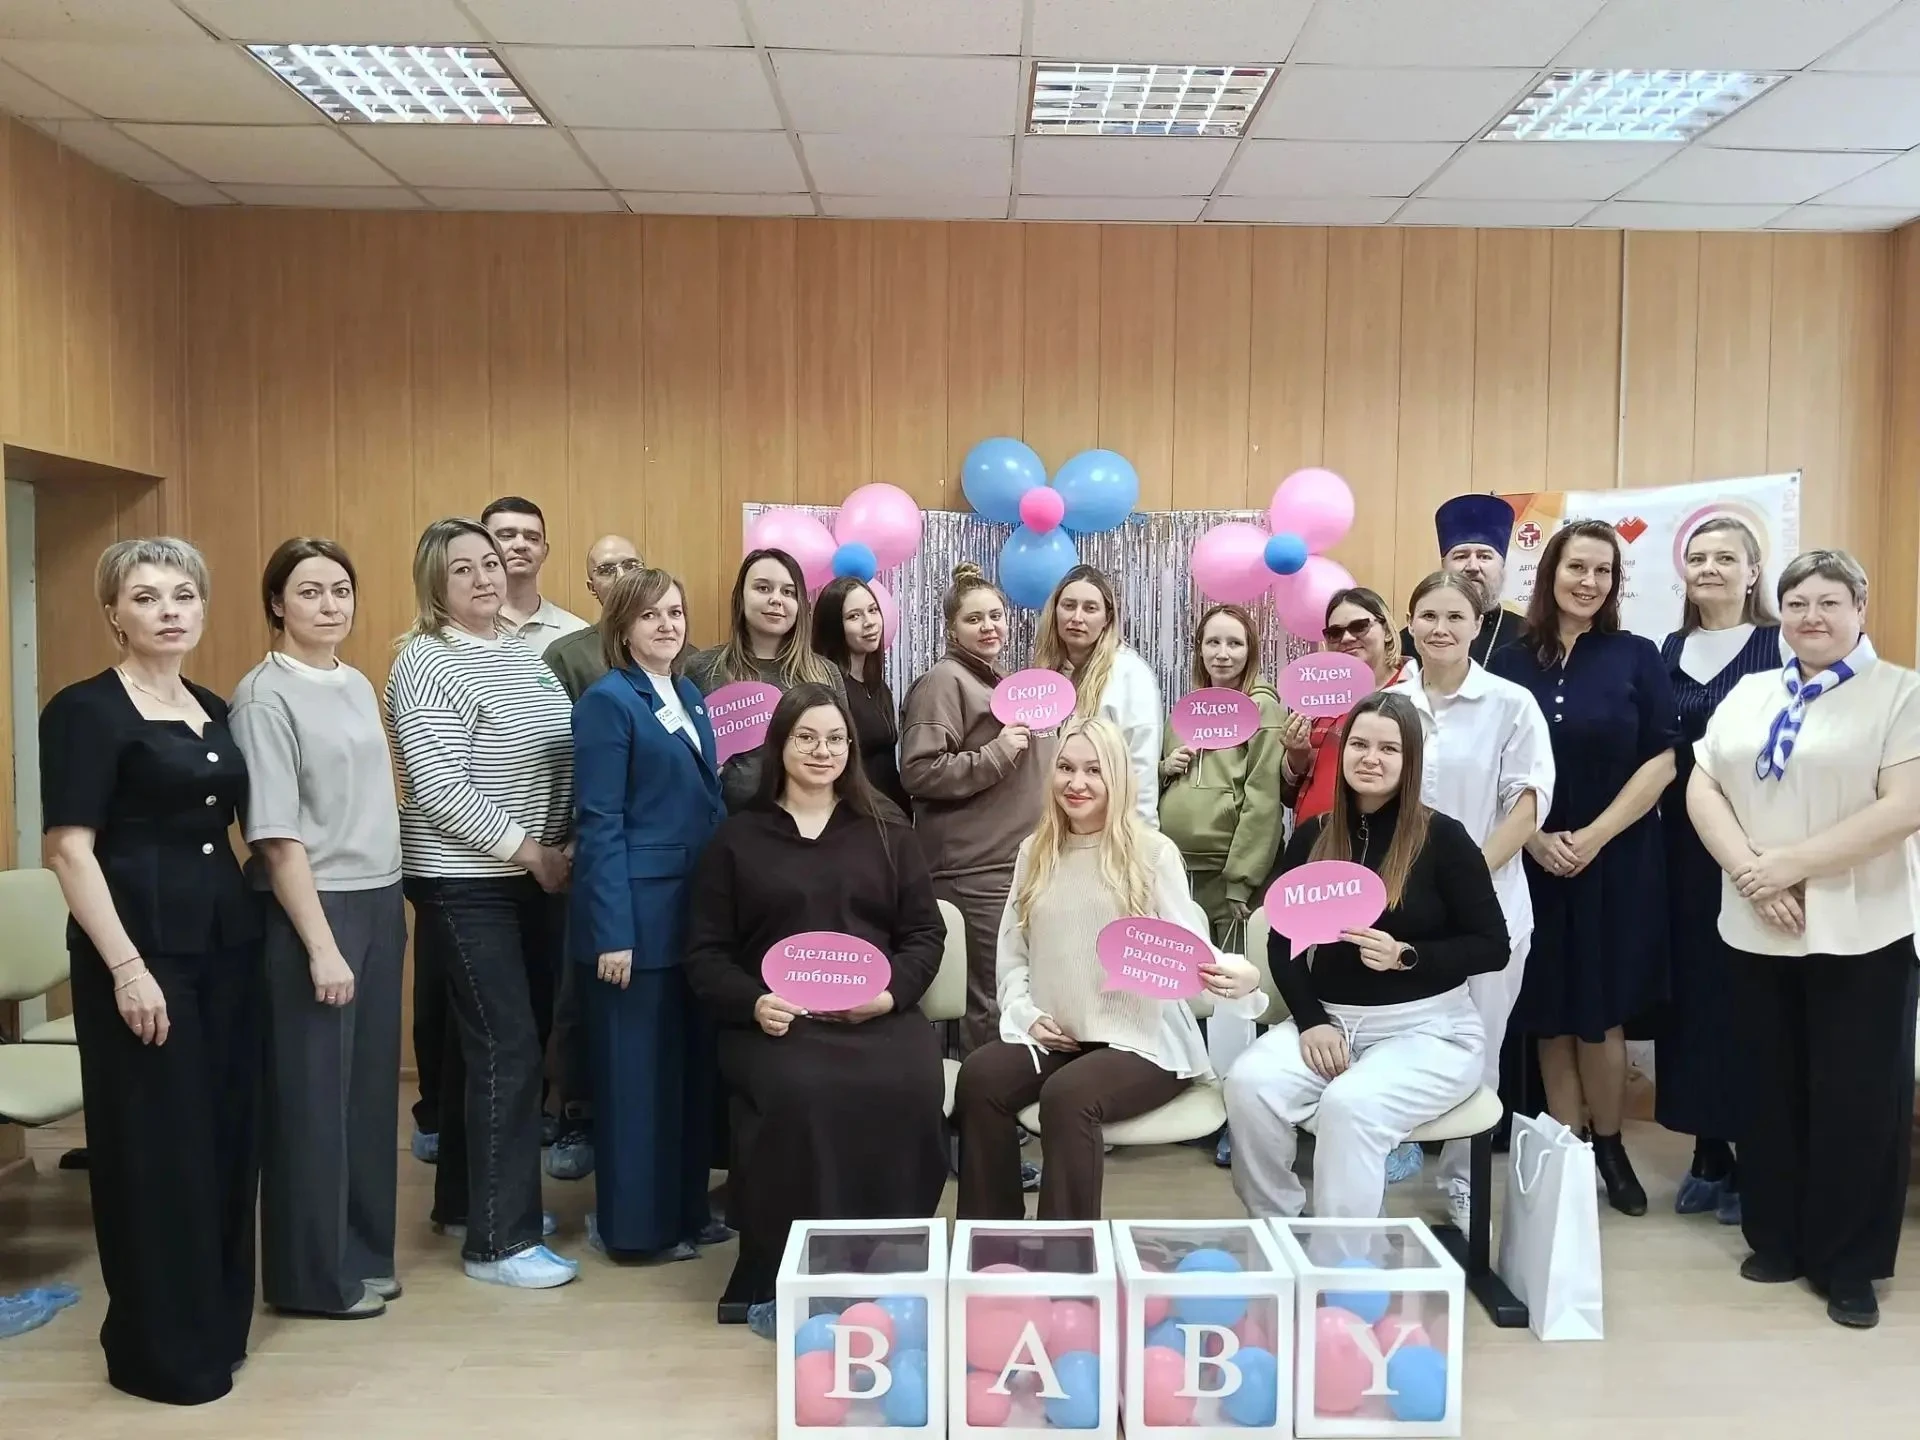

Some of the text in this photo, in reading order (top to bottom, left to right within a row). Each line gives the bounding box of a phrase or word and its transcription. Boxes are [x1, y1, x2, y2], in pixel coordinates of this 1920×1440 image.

[1299, 667, 1352, 682] Ждем
[1007, 682, 1057, 701] Скоро
[1301, 690, 1352, 706] сына!
[1015, 702, 1058, 723] буду!
[1190, 702, 1239, 715] Ждем
[1193, 724, 1238, 740] дочь!
[1284, 877, 1362, 908] Мама
[1125, 926, 1194, 955] Скрытая
[784, 944, 873, 963] Сделано с
[1122, 946, 1187, 972] радость
[784, 969, 867, 985] любовью
[1122, 965, 1179, 990] внутри
